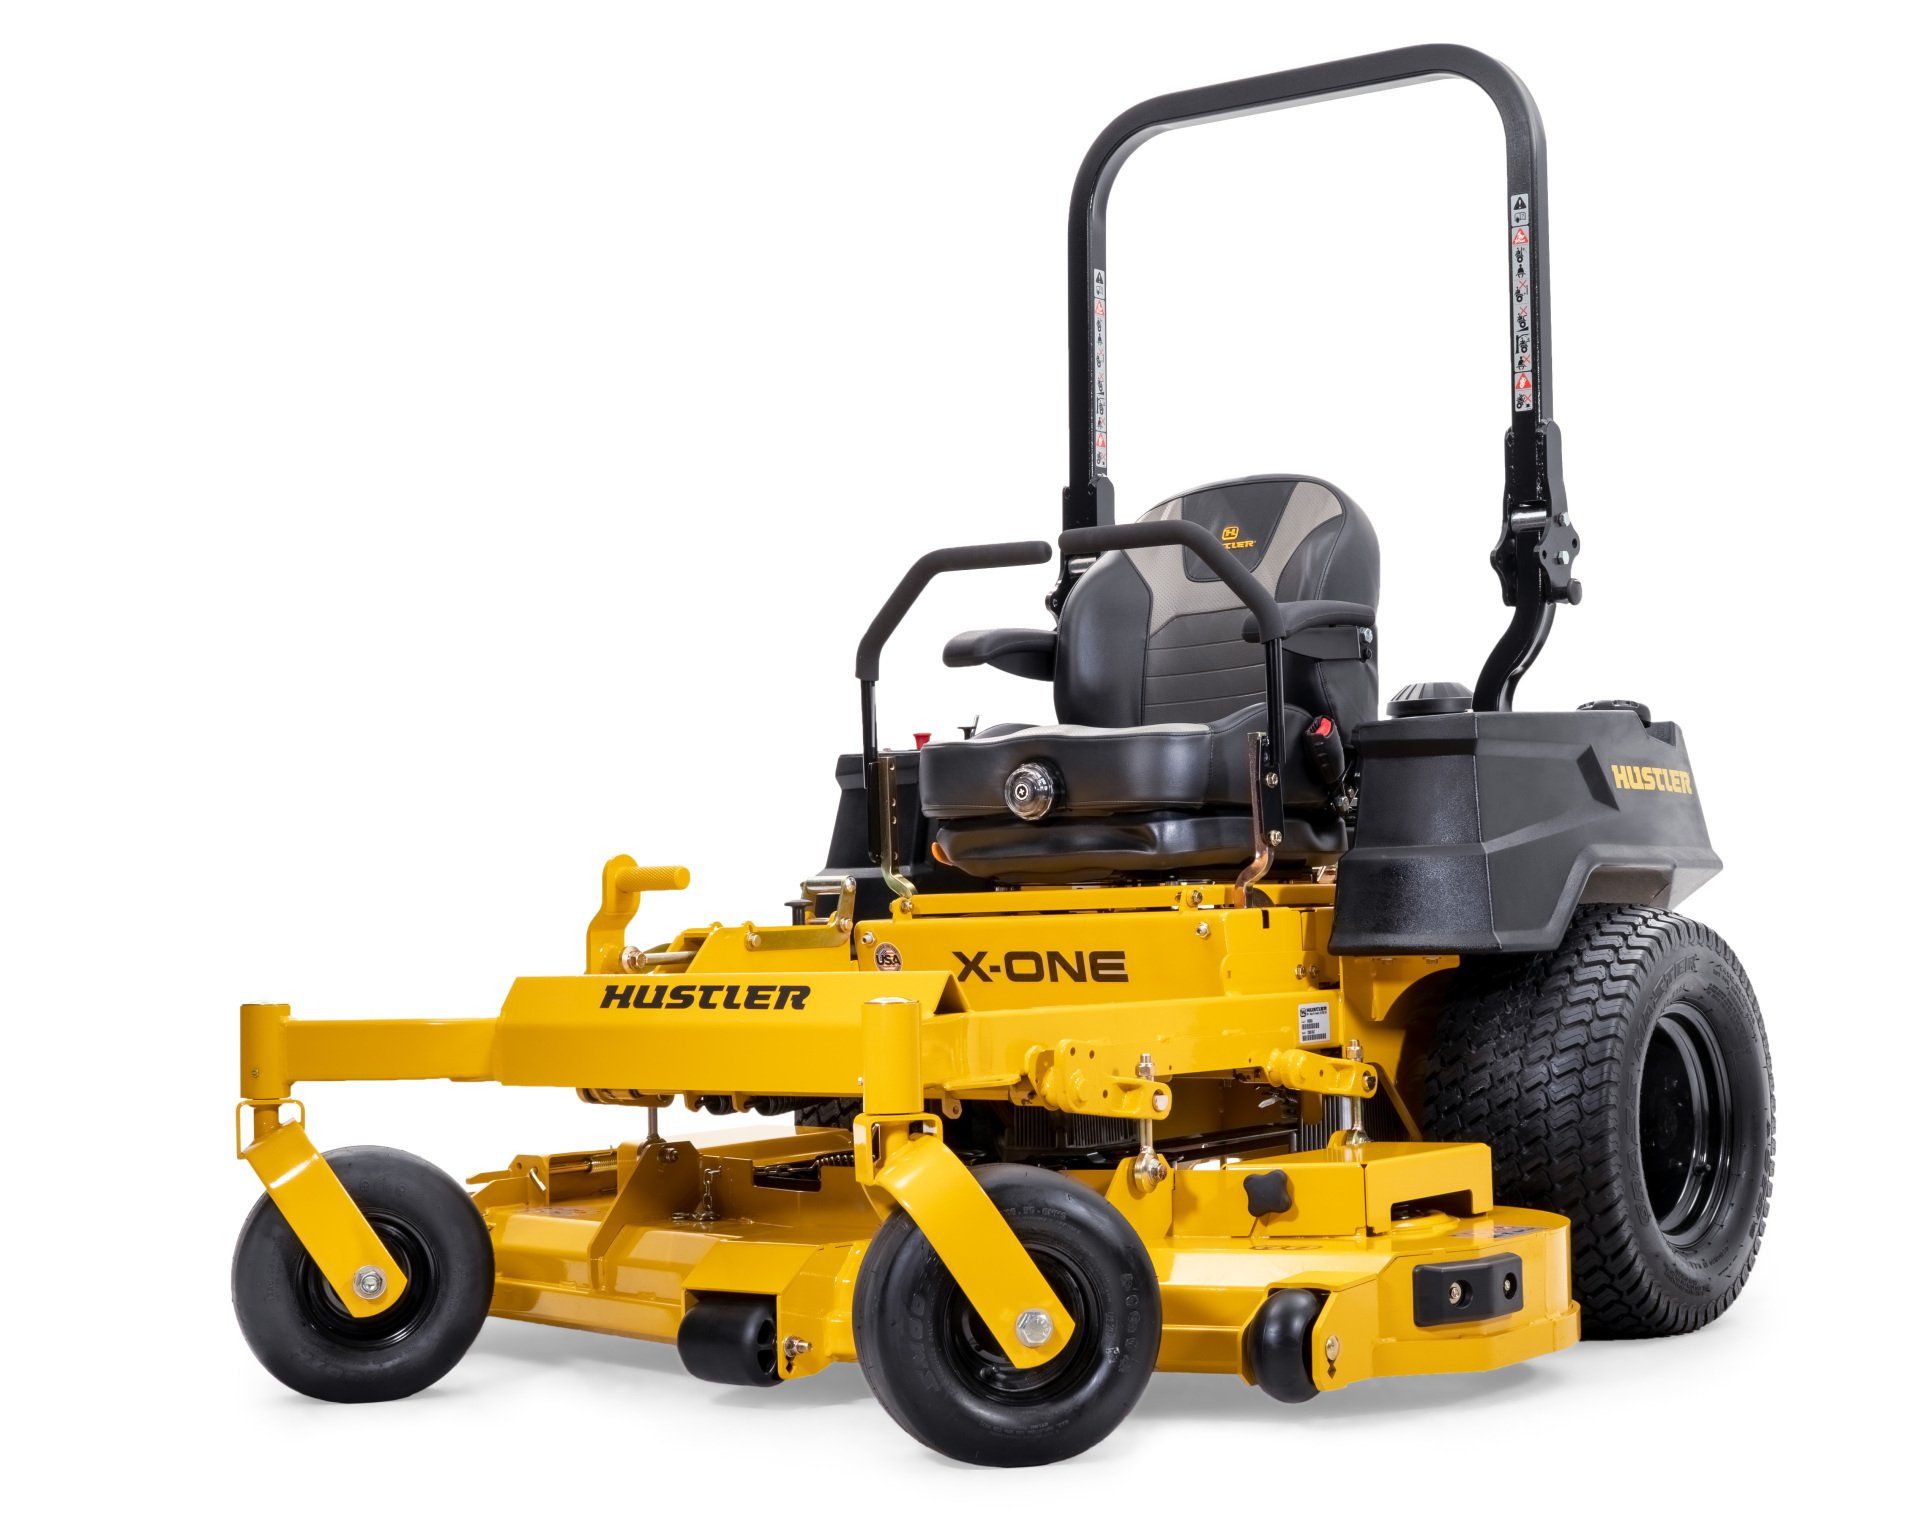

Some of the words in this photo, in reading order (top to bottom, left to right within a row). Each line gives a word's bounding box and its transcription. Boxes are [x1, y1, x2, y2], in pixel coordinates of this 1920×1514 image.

[1611, 765, 1692, 794] HUSTLER
[876, 954, 901, 965] USA
[952, 951, 1129, 982] X-ONE
[600, 985, 811, 1009] HUSTLER
